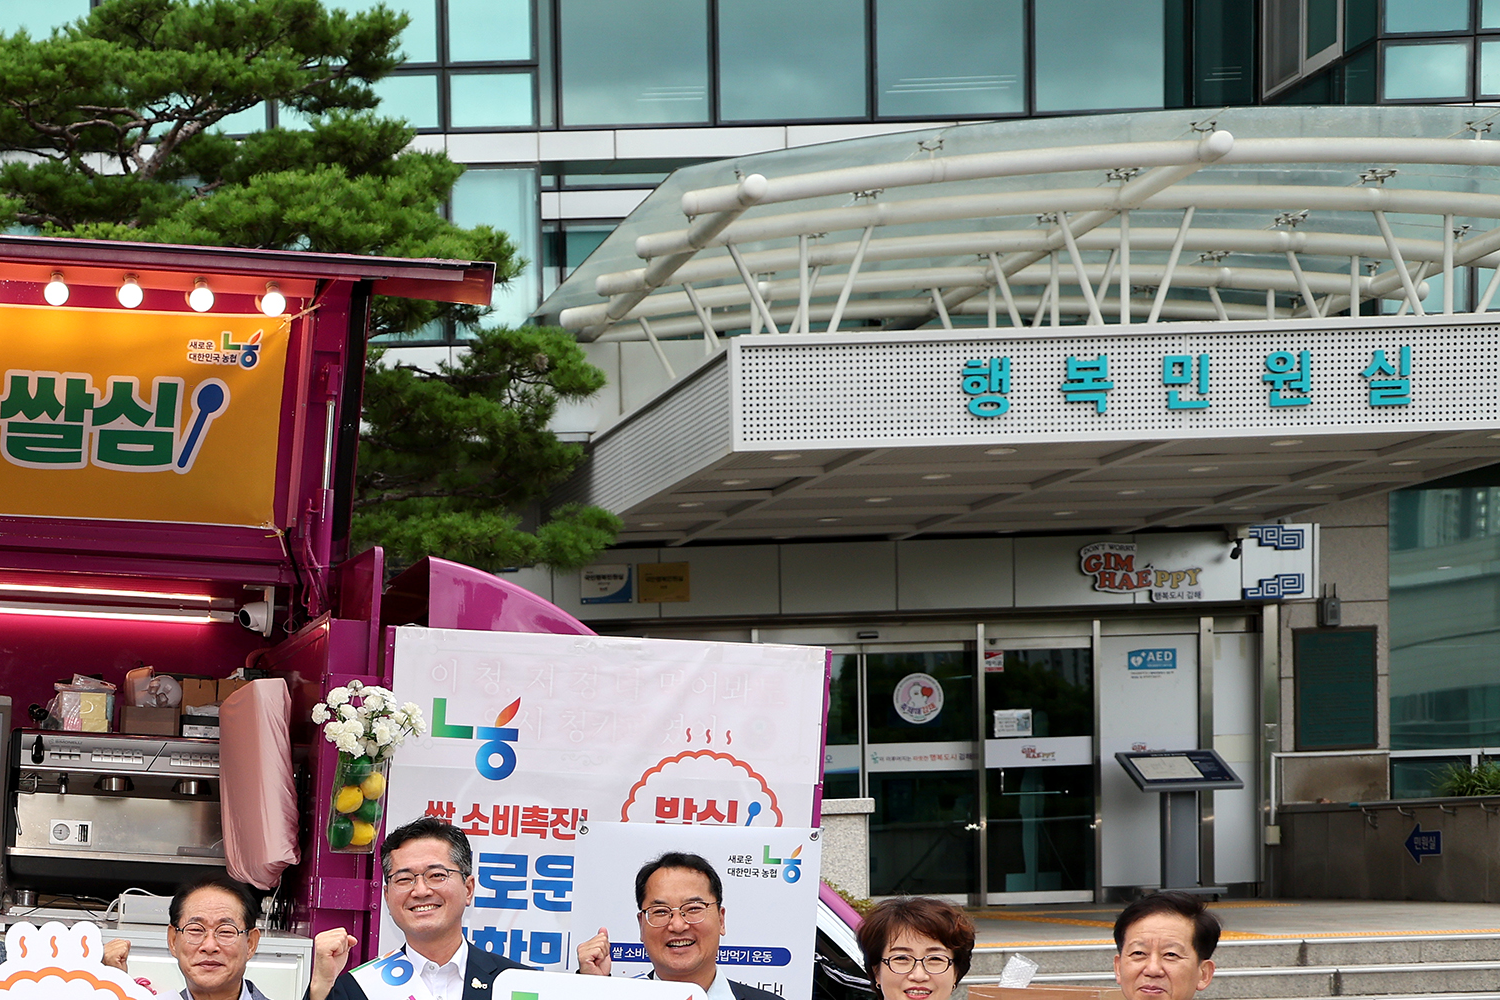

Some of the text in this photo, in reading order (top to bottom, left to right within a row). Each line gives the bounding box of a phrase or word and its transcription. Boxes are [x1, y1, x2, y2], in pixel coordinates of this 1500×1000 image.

[190, 341, 214, 350] 새로운
[189, 353, 238, 363] 대한민국 농협
[962, 346, 1412, 418] 행복민원실
[0, 375, 178, 466] 쌀심
[1083, 544, 1105, 555] DON'T
[1084, 553, 1134, 572] GIM
[1187, 590, 1202, 600] 김해
[1146, 651, 1173, 661] AED
[1414, 836, 1436, 850] 민원실
[728, 855, 754, 864] 새로운
[727, 867, 778, 879] 대한민국 농협
[466, 851, 574, 912] 로운
[612, 947, 650, 959] 쌀 소비
[752, 951, 773, 963] 운동
